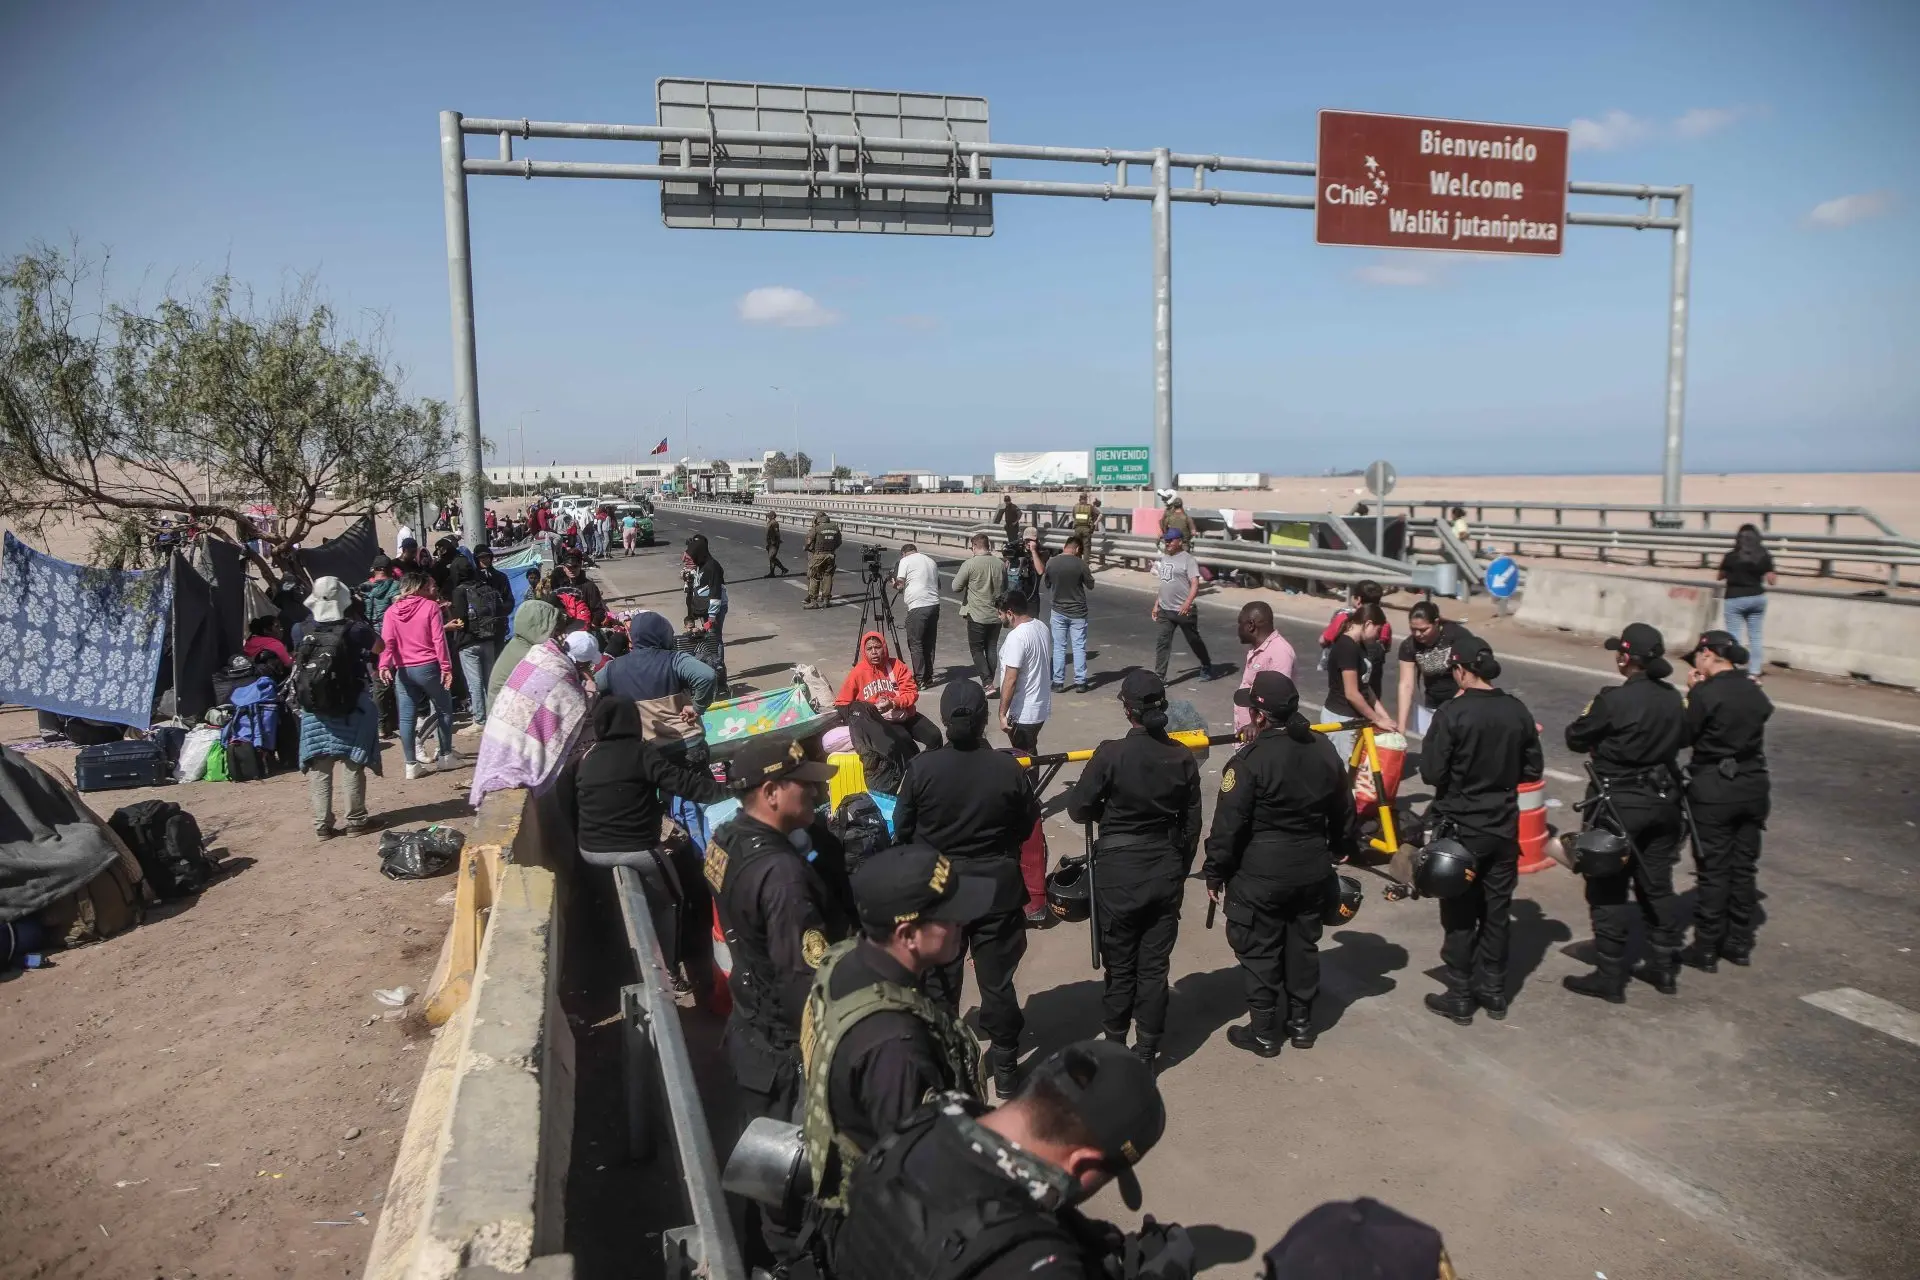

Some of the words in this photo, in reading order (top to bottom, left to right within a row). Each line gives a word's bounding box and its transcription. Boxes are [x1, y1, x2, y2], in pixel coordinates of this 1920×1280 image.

[1419, 129, 1538, 162] Bienvenido
[1325, 183, 1379, 207] Chile
[1430, 170, 1524, 200] Welcome
[1389, 207, 1450, 235] Waliki
[1452, 211, 1558, 243] jutaniptaxa
[1096, 450, 1148, 460] BIENVENIDO
